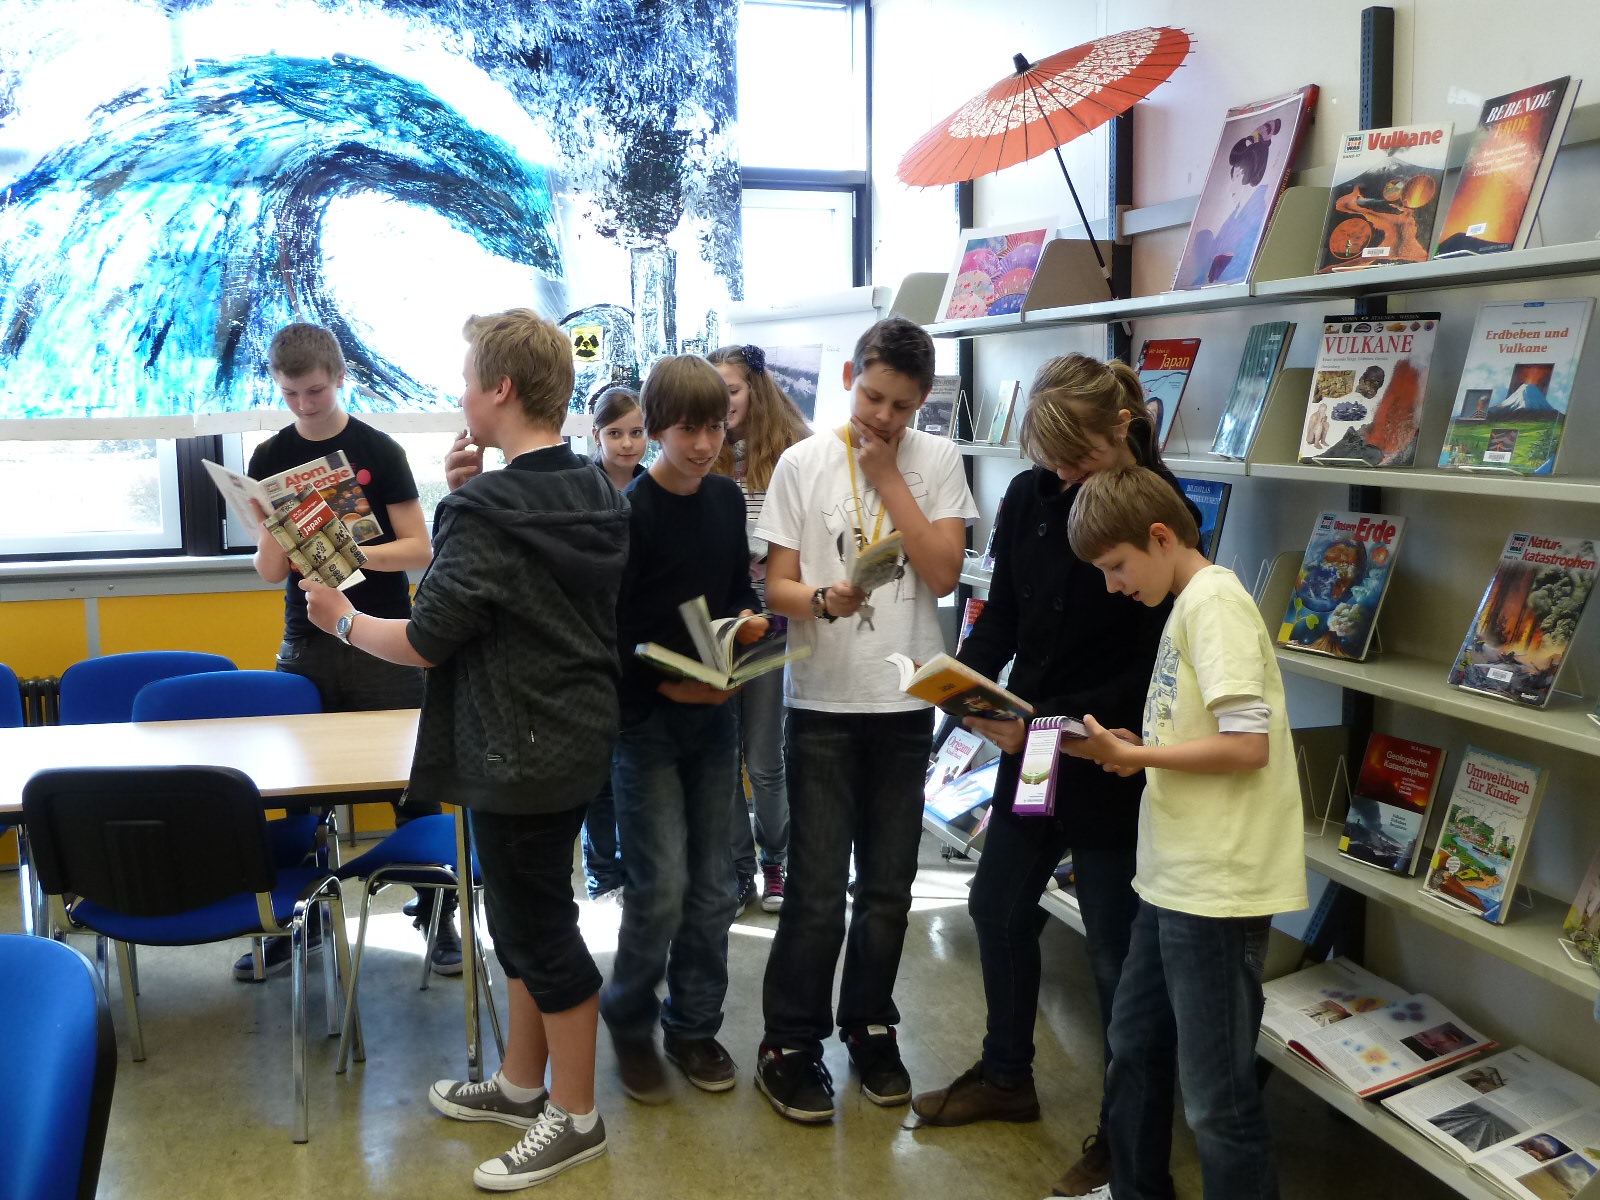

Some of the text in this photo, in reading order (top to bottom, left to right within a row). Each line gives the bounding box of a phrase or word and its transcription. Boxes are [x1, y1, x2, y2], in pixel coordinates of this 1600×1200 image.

[1486, 90, 1556, 123] BEBENDE
[1494, 114, 1532, 138] ERDE
[1367, 129, 1444, 150] Vulkane
[1325, 334, 1414, 354] VULKANE
[1486, 327, 1569, 340] Erdbeben und
[1499, 343, 1548, 353] Vulkane
[1160, 353, 1190, 370] Japan
[285, 465, 327, 489] Atom
[294, 469, 351, 494] Eergie
[303, 516, 323, 536] Japan
[1333, 517, 1396, 544] Unsere Erde
[1528, 535, 1562, 550] Natur-
[1522, 549, 1596, 571] katastrophen
[948, 735, 975, 756] Origami
[1383, 760, 1429, 779] Katastrophen
[1386, 750, 1428, 768] Geologische
[1466, 762, 1530, 795] Umweltbuch
[1467, 777, 1484, 793] für
[1485, 783, 1520, 805] Kinder
